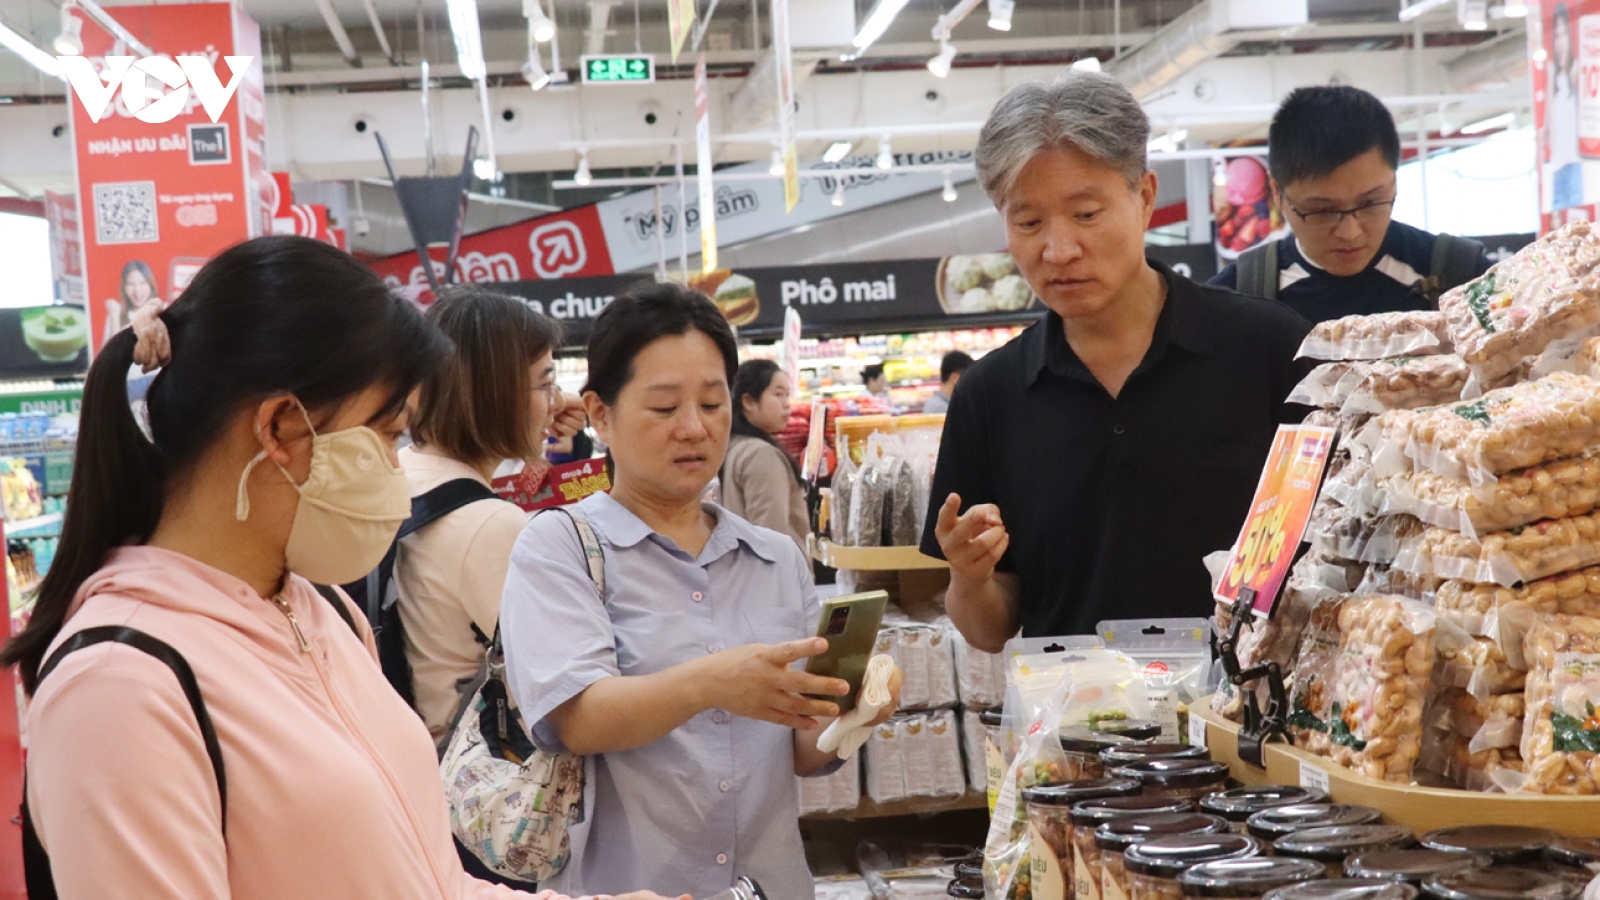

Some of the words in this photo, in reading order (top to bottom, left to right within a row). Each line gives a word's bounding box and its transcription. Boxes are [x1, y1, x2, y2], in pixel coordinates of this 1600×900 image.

[88, 138, 133, 158] NHẬN
[781, 276, 838, 306] Phô
[844, 274, 896, 303] mai
[583, 462, 594, 475] 4
[1229, 500, 1293, 588] 50%
